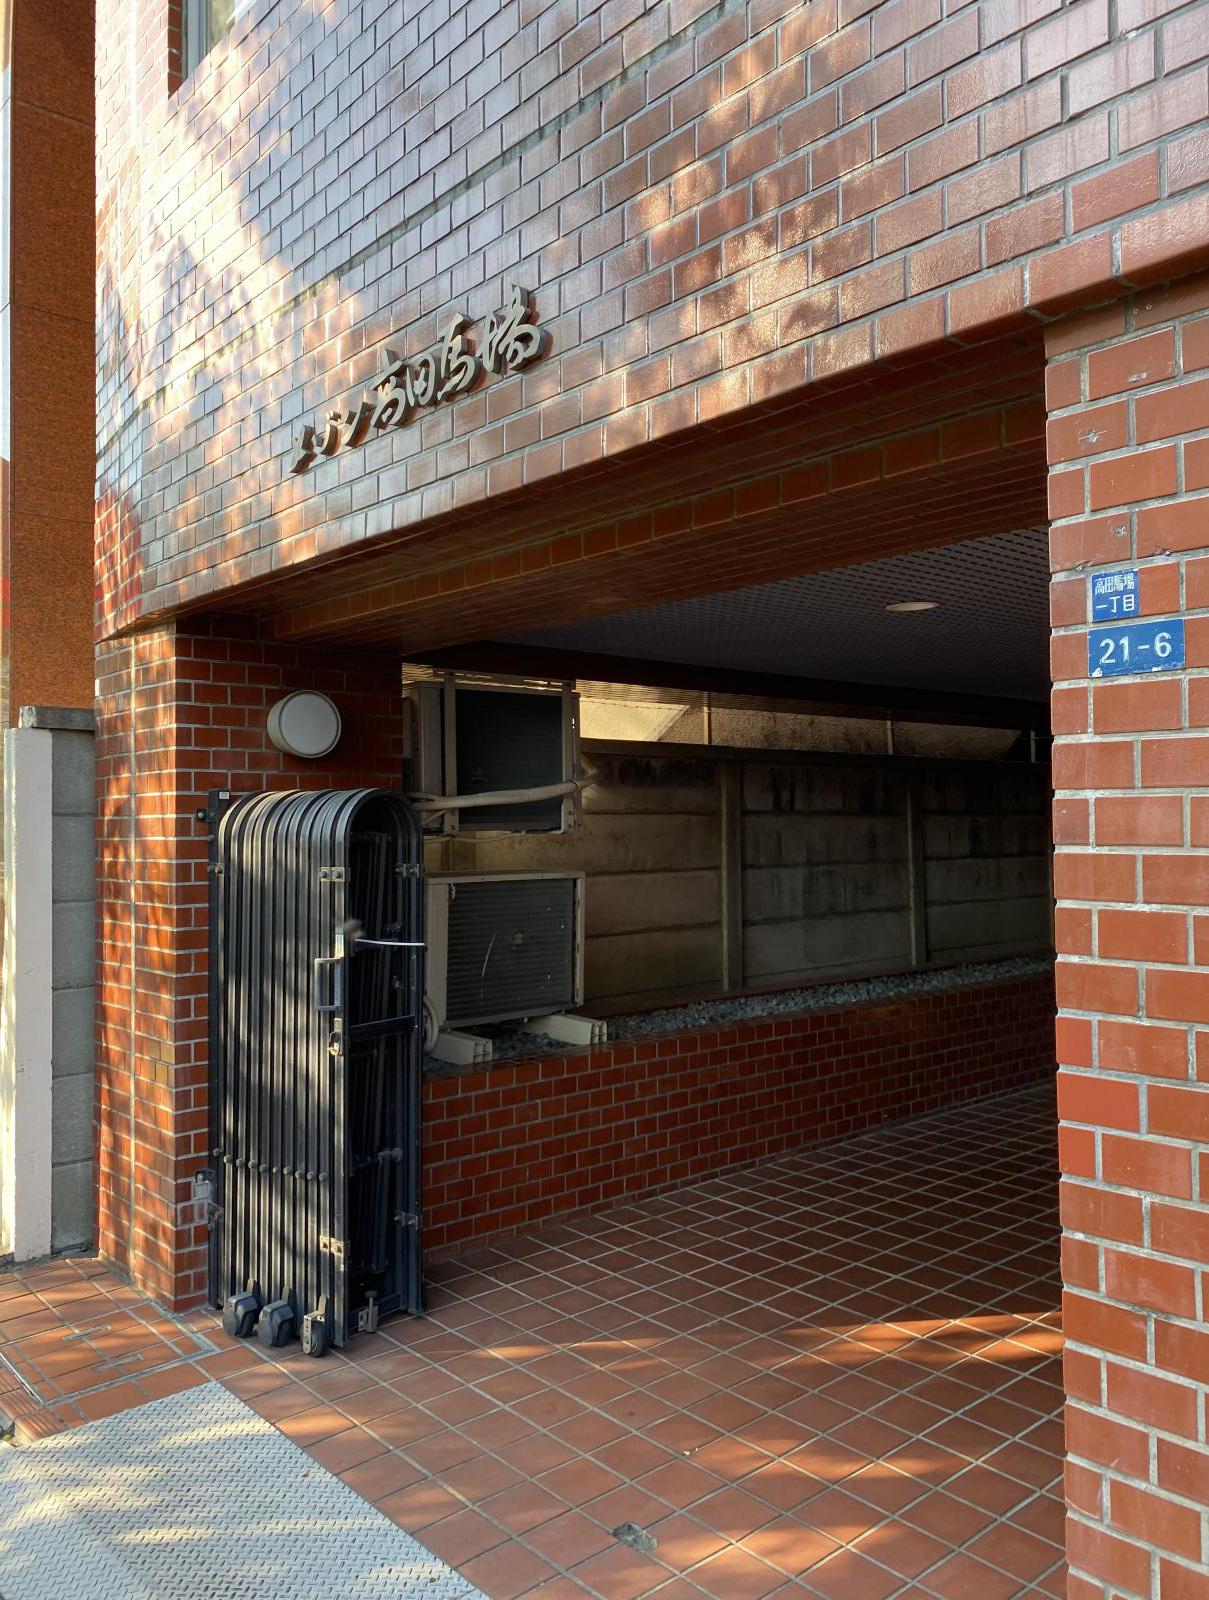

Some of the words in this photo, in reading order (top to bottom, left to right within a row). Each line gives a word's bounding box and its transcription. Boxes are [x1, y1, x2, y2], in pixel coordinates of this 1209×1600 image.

[1095, 573, 1135, 595] 高田馬場
[1095, 594, 1135, 613] 一丁目
[1099, 632, 1172, 664] 21-6
